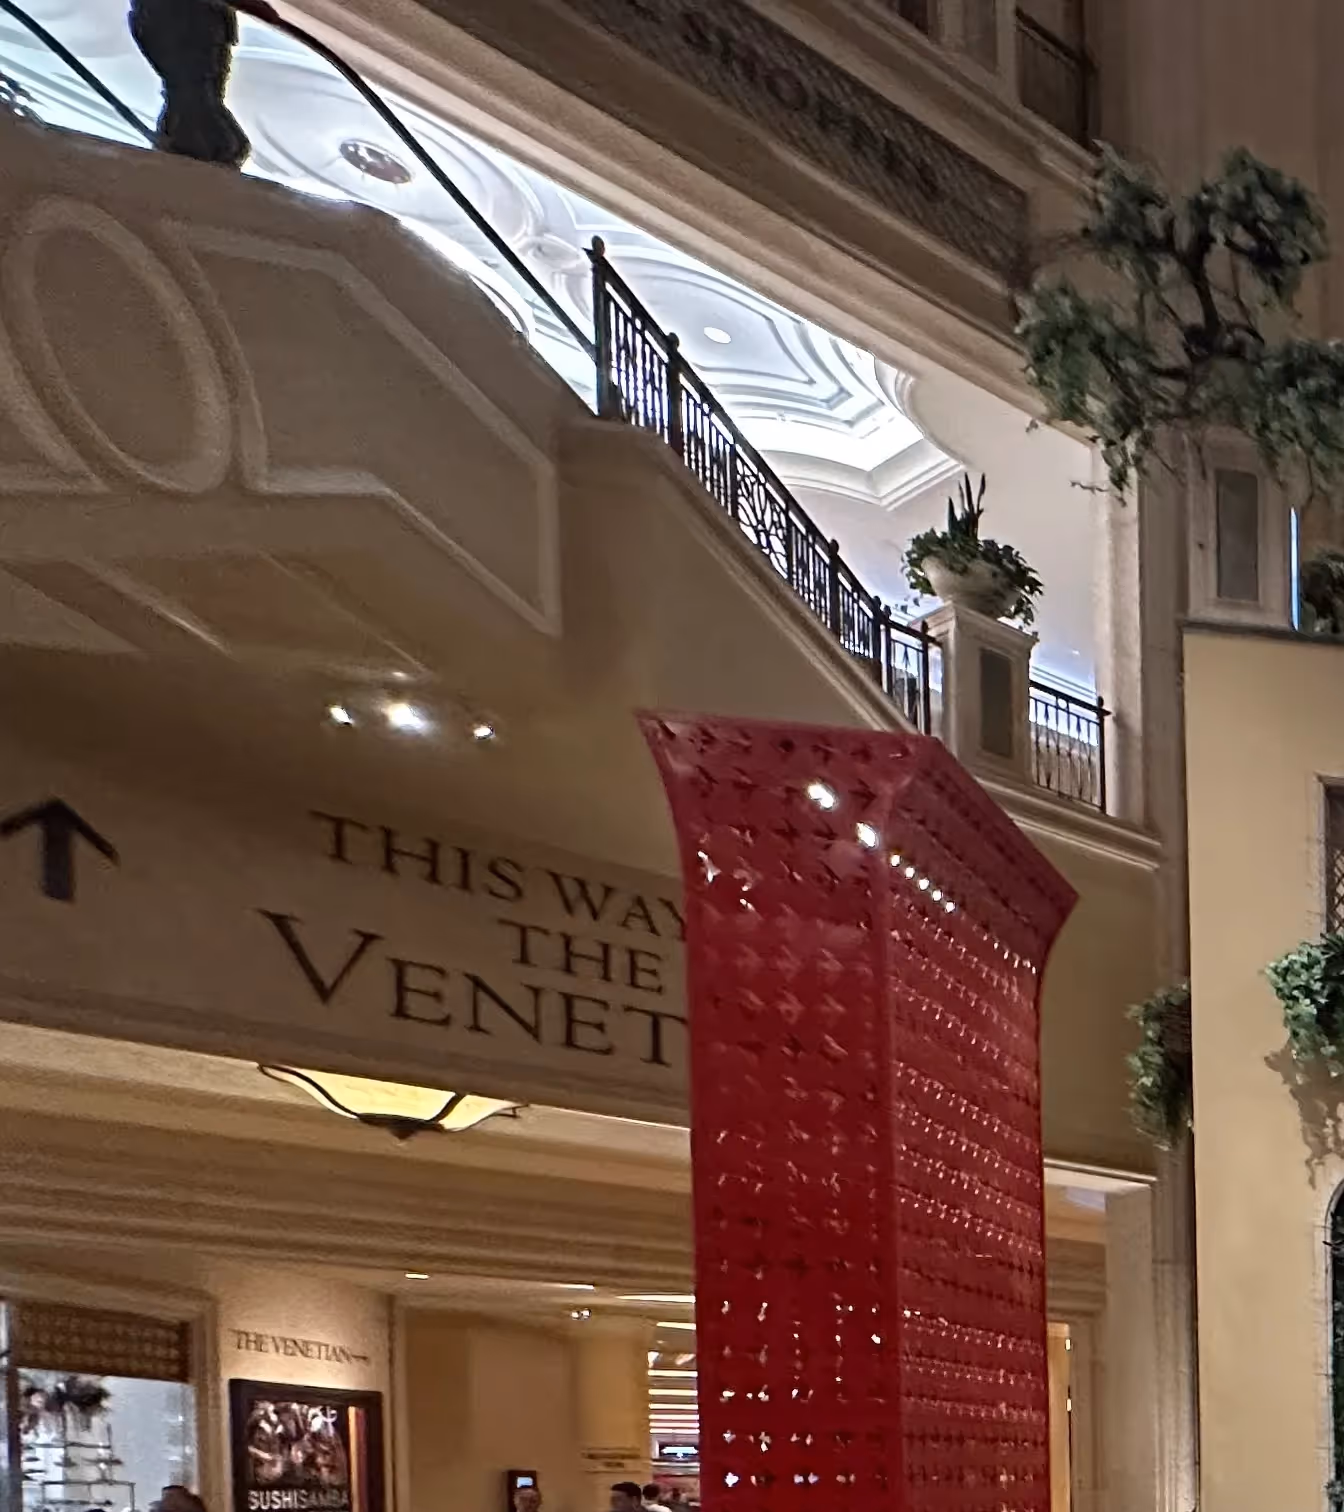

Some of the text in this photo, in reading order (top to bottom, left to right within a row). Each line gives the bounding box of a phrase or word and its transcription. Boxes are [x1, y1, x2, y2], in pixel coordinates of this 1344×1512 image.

[309, 808, 688, 942] THIS WAY
[497, 917, 665, 996] THE
[227, 1327, 352, 1364] THE VENETIAN
